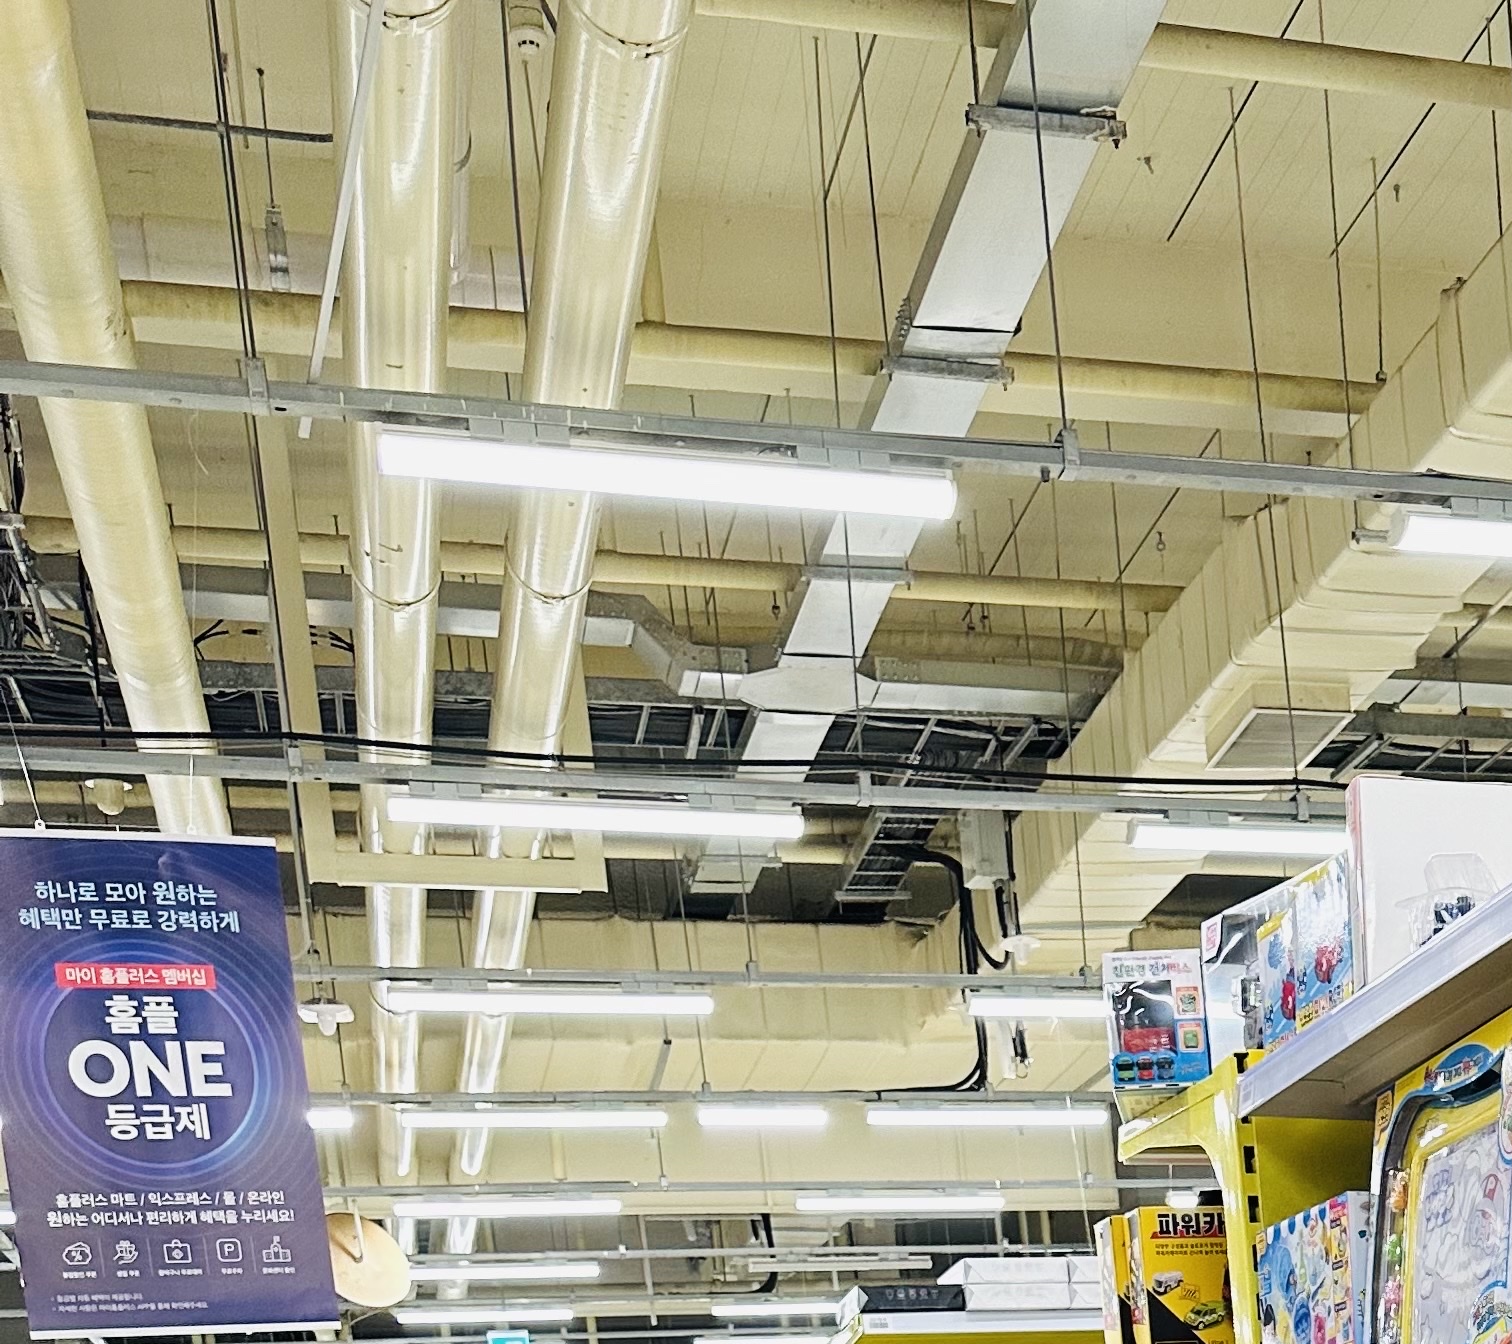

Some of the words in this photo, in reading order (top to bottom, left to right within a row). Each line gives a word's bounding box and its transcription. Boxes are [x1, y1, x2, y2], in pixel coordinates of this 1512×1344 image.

[34, 881, 99, 903] 하나로
[105, 881, 147, 904] 모아
[152, 881, 218, 906] 원하는
[18, 907, 83, 930] 혜택만
[89, 908, 152, 930] 무료로
[157, 909, 240, 933] 강력하게
[65, 967, 97, 984] 마이
[100, 968, 160, 985] 홈플러스
[162, 968, 207, 985] 멤버십
[105, 995, 179, 1035] 홈플
[68, 1040, 233, 1098] ONE
[105, 1103, 211, 1141] 등급제
[55, 1193, 109, 1208] 홈플러스
[110, 1192, 138, 1207] 마트
[148, 1191, 213, 1206] 익스프레스
[247, 1190, 285, 1206] 온라인
[47, 1211, 89, 1228] 원하는
[91, 1211, 144, 1227] 어디서나
[146, 1210, 198, 1226] 편리하게
[199, 1209, 239, 1225] 혜택을
[241, 1208, 295, 1223] 누리세요!
